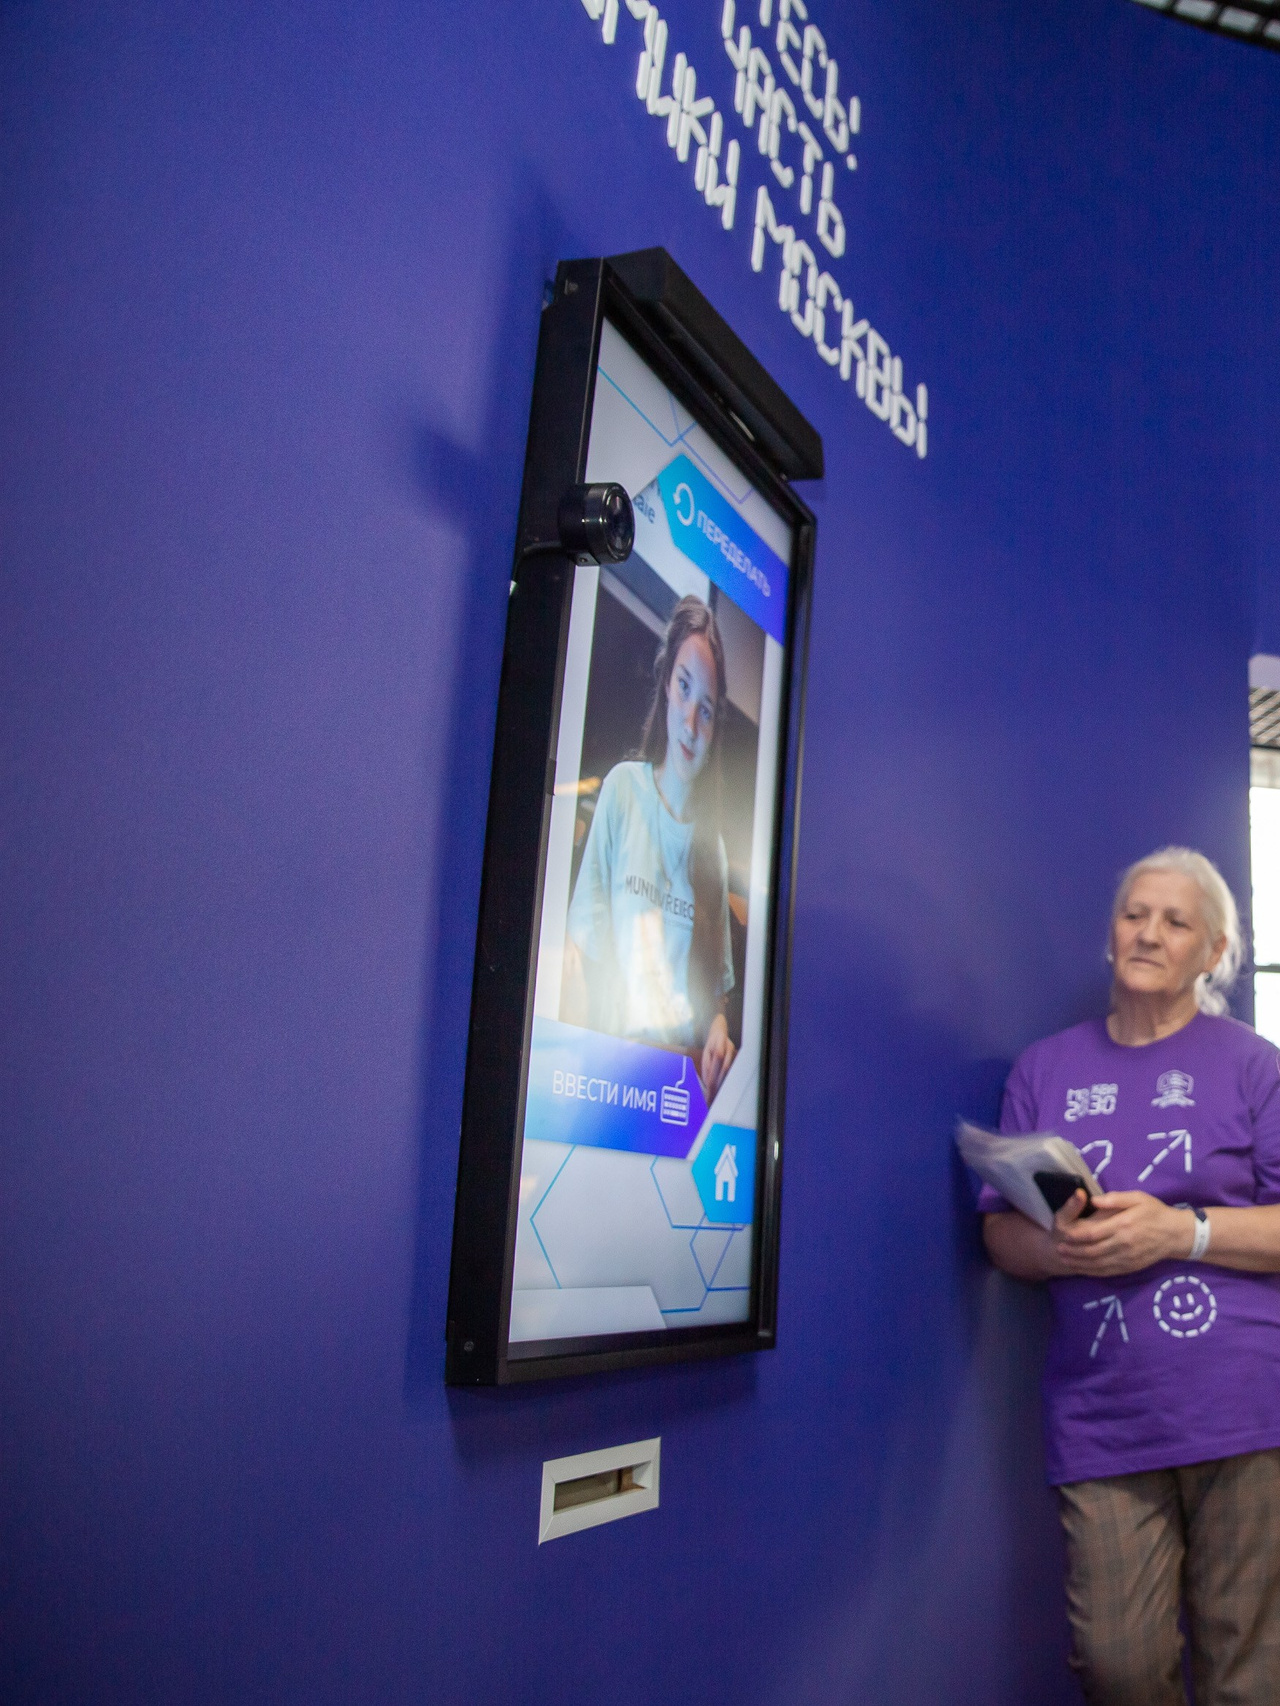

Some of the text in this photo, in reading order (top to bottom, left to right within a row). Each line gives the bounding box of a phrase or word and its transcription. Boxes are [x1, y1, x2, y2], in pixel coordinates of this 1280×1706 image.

[720, 0, 845, 258] ЧАСТЬ
[759, 0, 861, 170] ЕСЬ!
[578, 0, 927, 459] МИКИ МОСКВЫ
[552, 1070, 657, 1112] ВВЕСТИ ИМЯ
